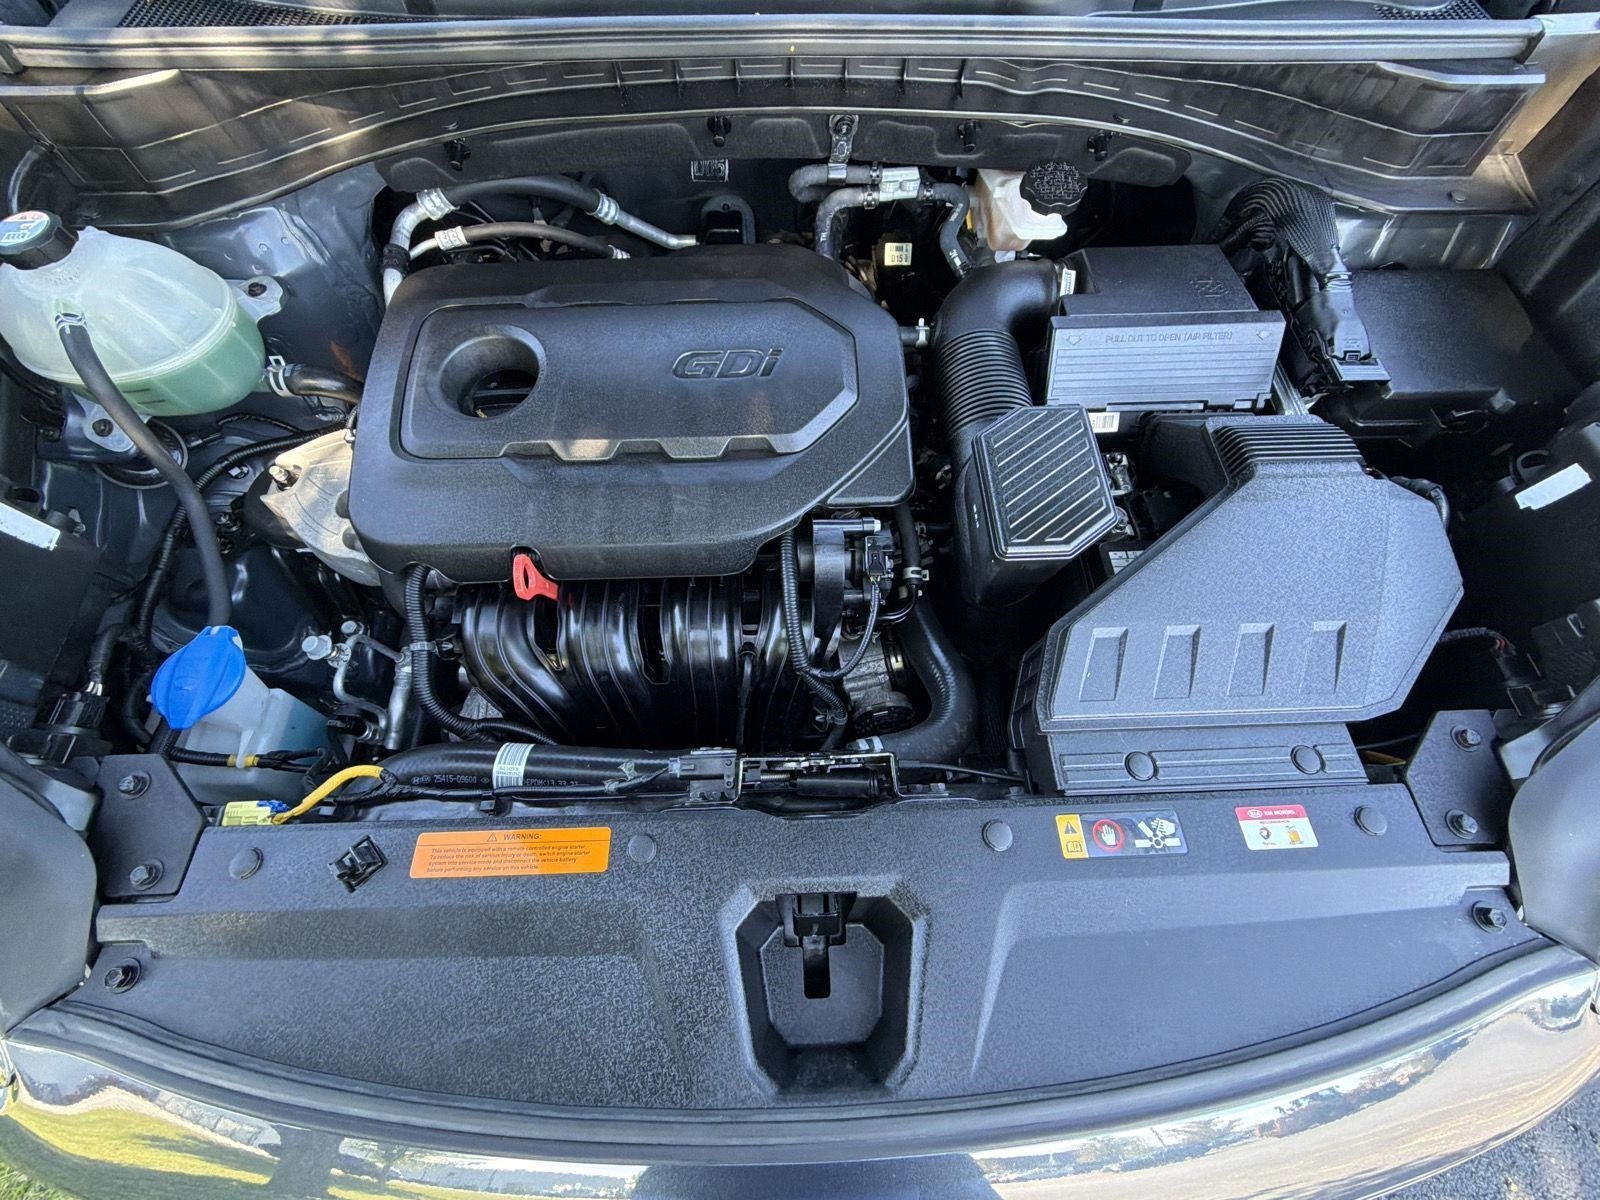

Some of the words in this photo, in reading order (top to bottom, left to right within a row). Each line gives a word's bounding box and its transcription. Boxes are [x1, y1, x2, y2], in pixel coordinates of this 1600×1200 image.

[1105, 334, 1127, 344] PULL
[1127, 334, 1145, 343] OUT
[1146, 333, 1158, 342] TO
[1158, 332, 1181, 342] OPEN
[672, 348, 783, 379] GDi
